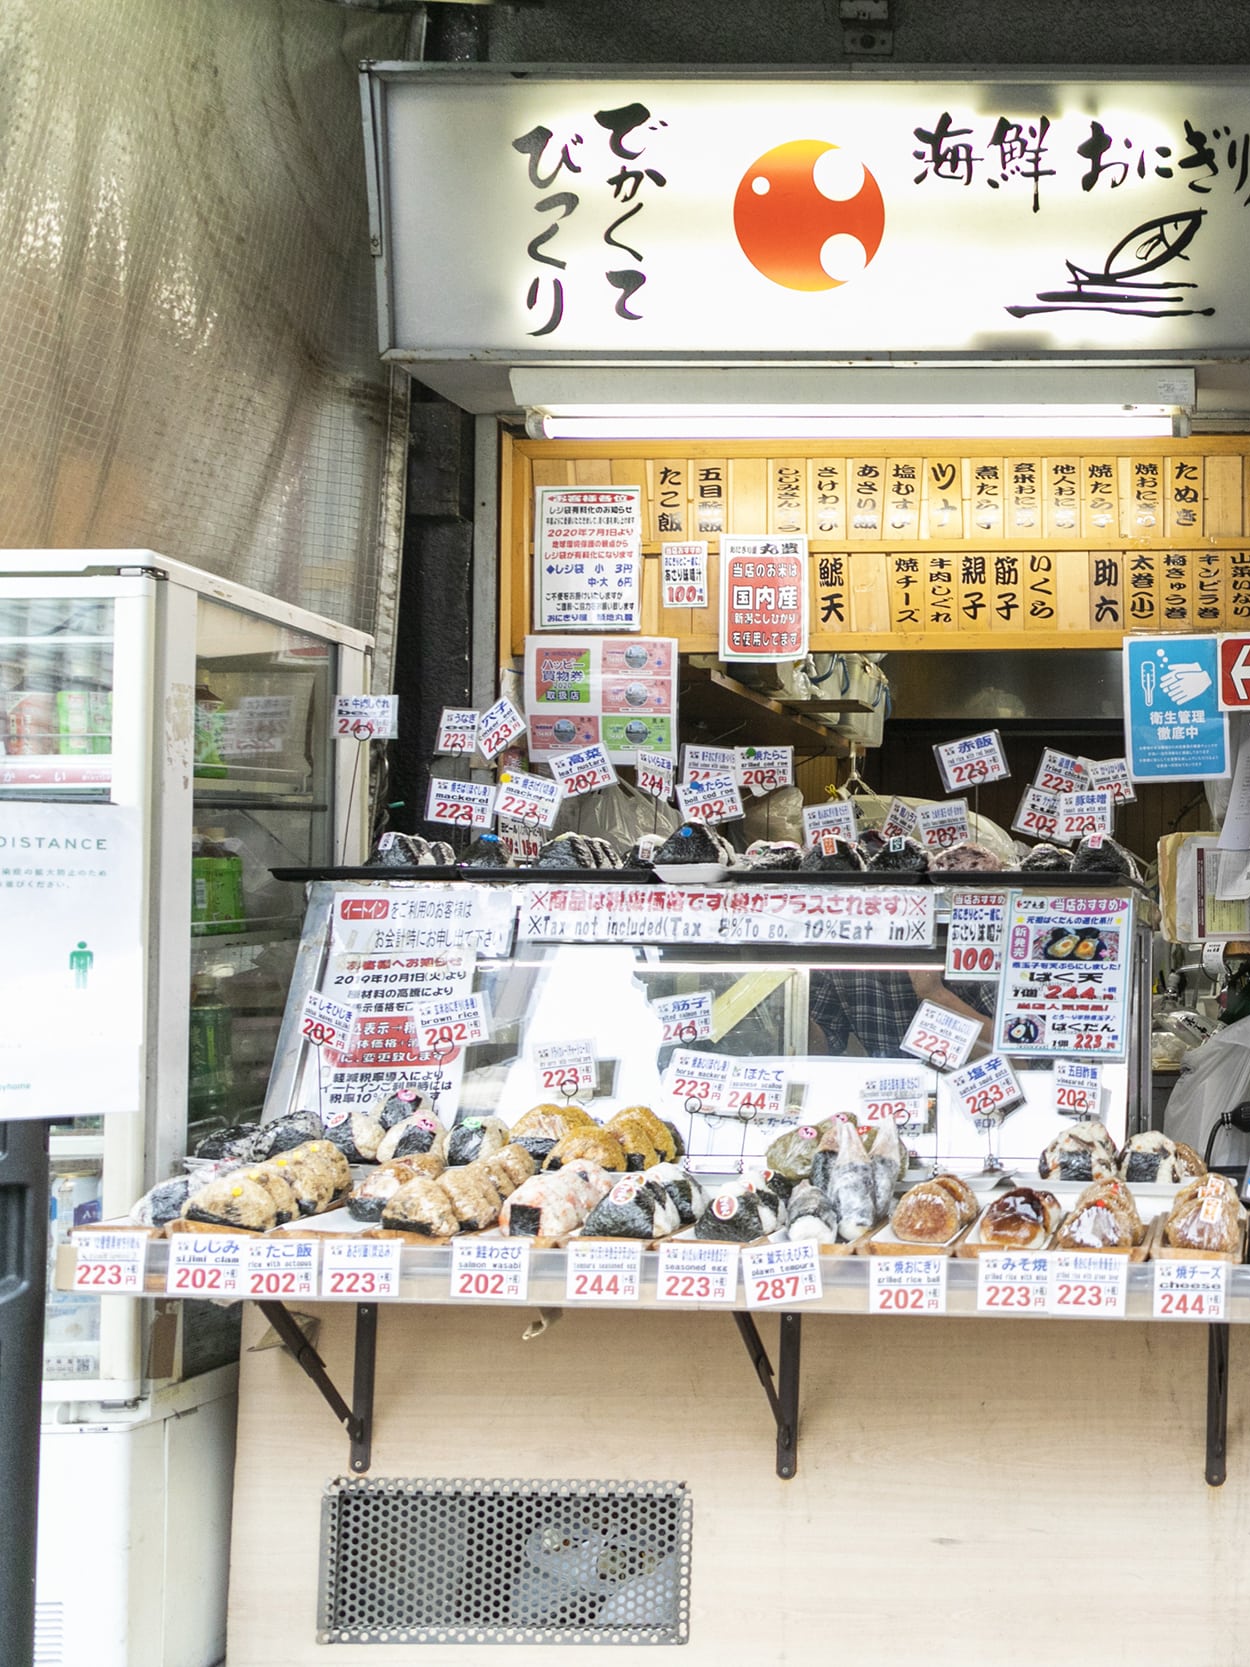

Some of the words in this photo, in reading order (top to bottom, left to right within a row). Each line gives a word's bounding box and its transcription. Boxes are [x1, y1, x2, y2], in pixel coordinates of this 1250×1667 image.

[912, 113, 1058, 213] 海鮮
[594, 101, 667, 323] でかくて
[511, 123, 584, 337] びっくり
[658, 466, 683, 533] たこ飯
[777, 466, 801, 533] しじみさんう
[1174, 461, 1199, 527] たぬき
[732, 563, 798, 578] 当店のお米は
[732, 585, 799, 611] 国内産
[895, 557, 921, 624] 焼チーズ
[928, 557, 953, 624] 牛肉しぐれ
[961, 556, 987, 621] 親子
[994, 556, 1021, 622] 筋子
[1029, 555, 1055, 620] いくら
[1094, 558, 1120, 623] 助六
[1163, 554, 1188, 620] 梅きゅう巻
[1197, 554, 1222, 620] キンピラ巻
[732, 632, 799, 647] を使用してます
[1149, 710, 1206, 726] 衛生管理
[958, 735, 993, 754] 赤飯
[1157, 725, 1200, 741] 徹底中
[435, 792, 489, 804] mackerel
[574, 917, 598, 936] not
[743, 1067, 785, 1082] ほたて
[193, 1239, 240, 1254] しじみ
[266, 1242, 313, 1259] たこ飯
[476, 1245, 522, 1260] 鮭わさび
[894, 1260, 941, 1274] 焼おにぎり
[1001, 1257, 1048, 1272] みそ焼
[1175, 1265, 1222, 1280] 焼チーズ
